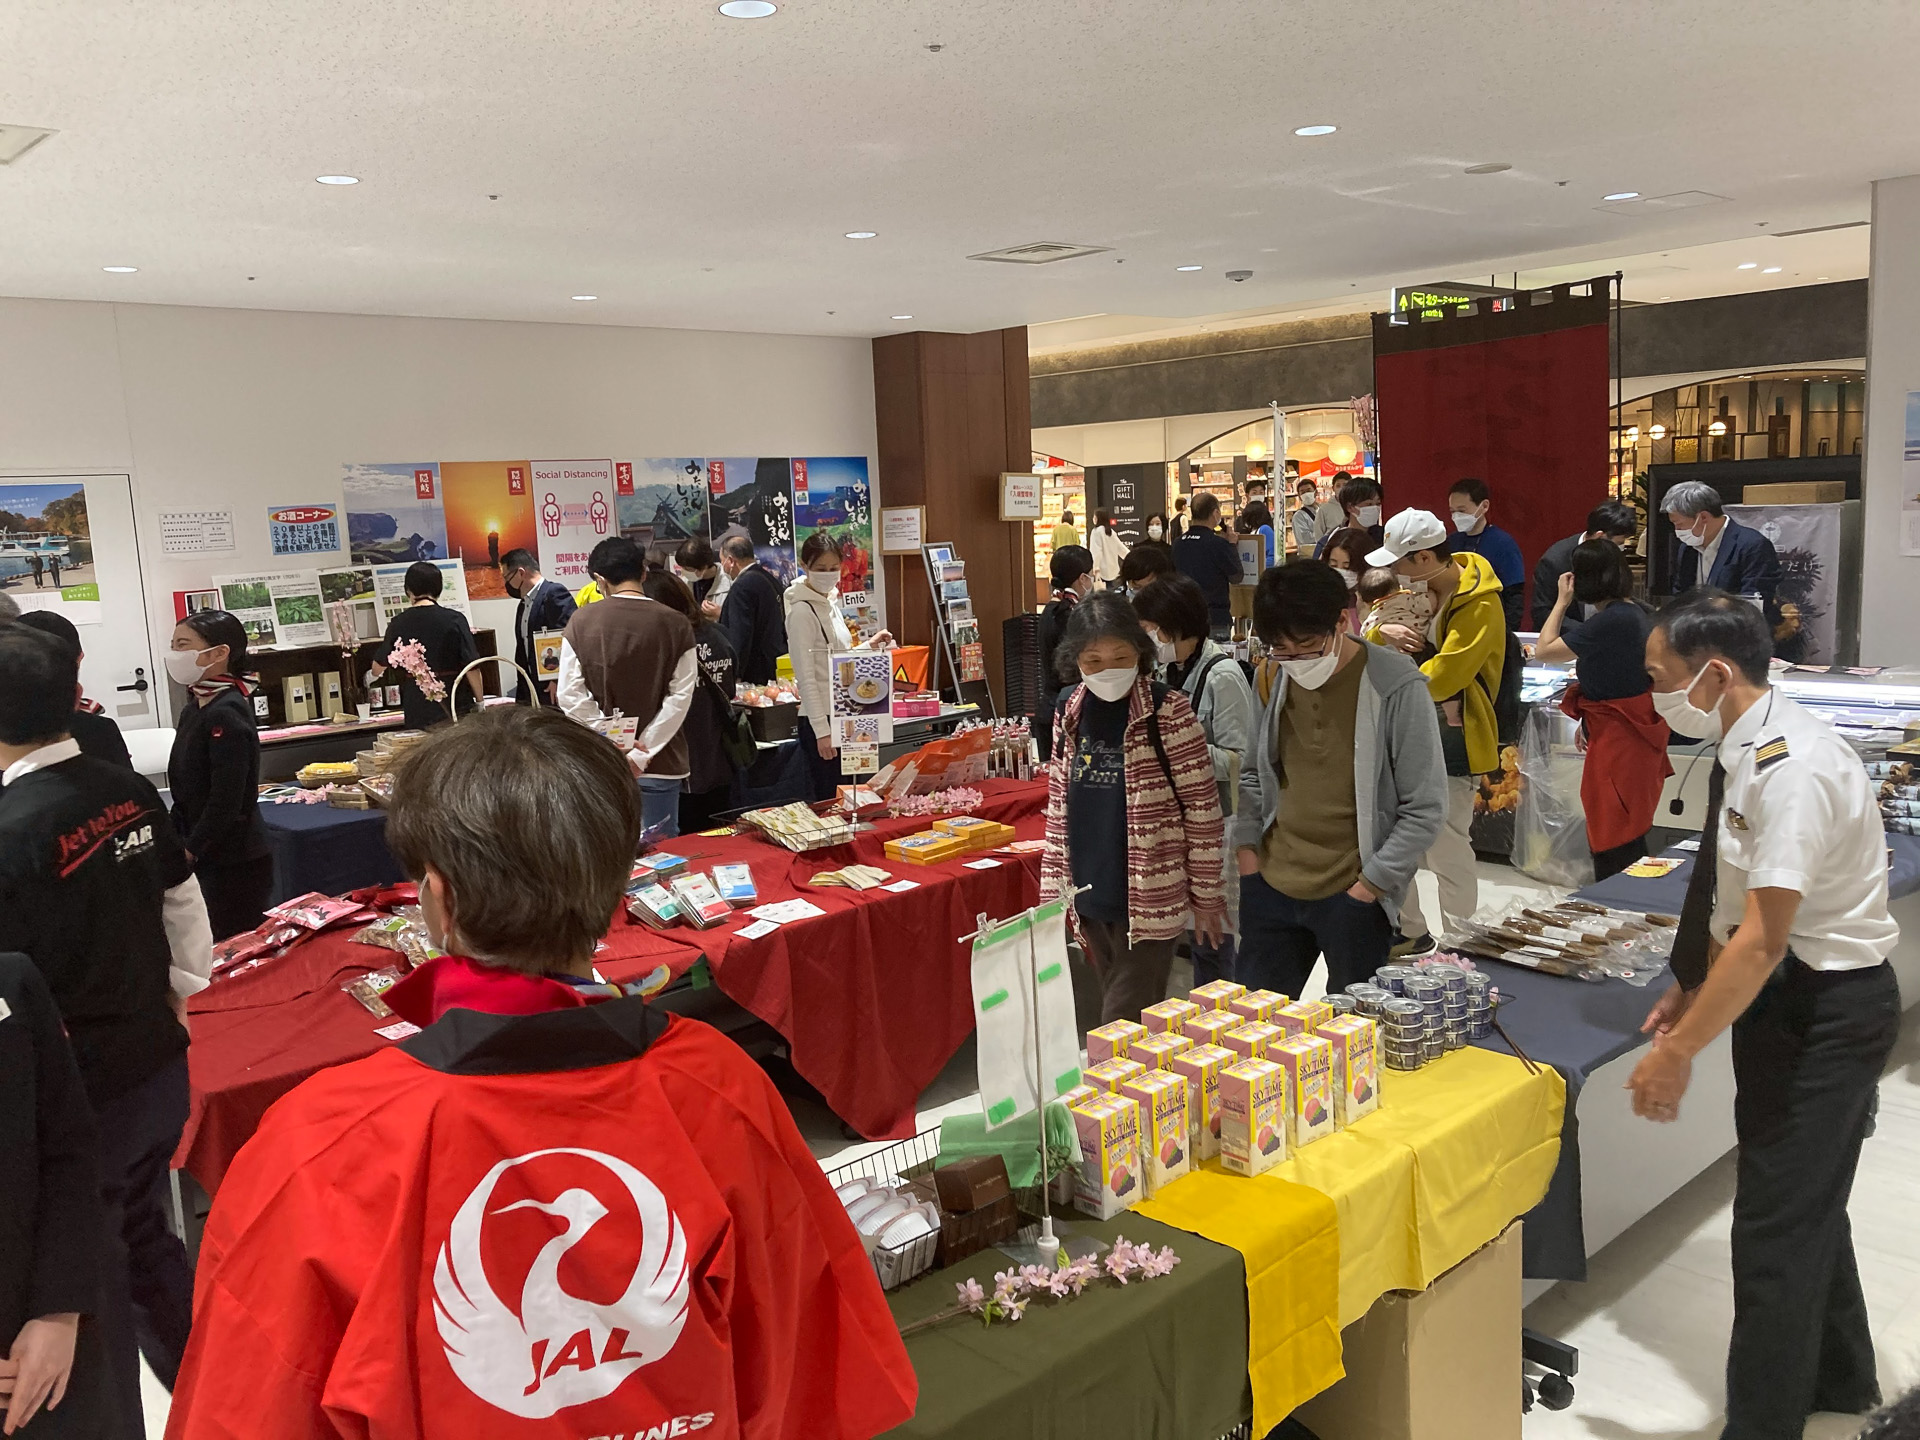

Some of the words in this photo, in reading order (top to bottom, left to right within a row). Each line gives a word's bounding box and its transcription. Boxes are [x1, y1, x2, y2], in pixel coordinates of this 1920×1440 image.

[536, 471, 561, 480] Social
[564, 470, 608, 480] Distancing
[278, 510, 330, 521] お酒コーナー
[555, 552, 591, 563] 間隔をあ
[845, 592, 866, 606] Entô
[58, 827, 88, 863] Jet
[1348, 1044, 1359, 1056] SKY
[1358, 1035, 1373, 1052] TIME
[1299, 1061, 1312, 1076] SKY
[1311, 1055, 1330, 1071] TIME
[1205, 1075, 1217, 1089] SKY
[1253, 1090, 1264, 1103] SKY
[1264, 1080, 1282, 1097] TIME
[1155, 1101, 1167, 1116] SKY
[1167, 1092, 1185, 1109] TIME
[1104, 1127, 1118, 1143] SKY
[1117, 1117, 1137, 1135] TIME
[522, 1327, 643, 1397] JAL
